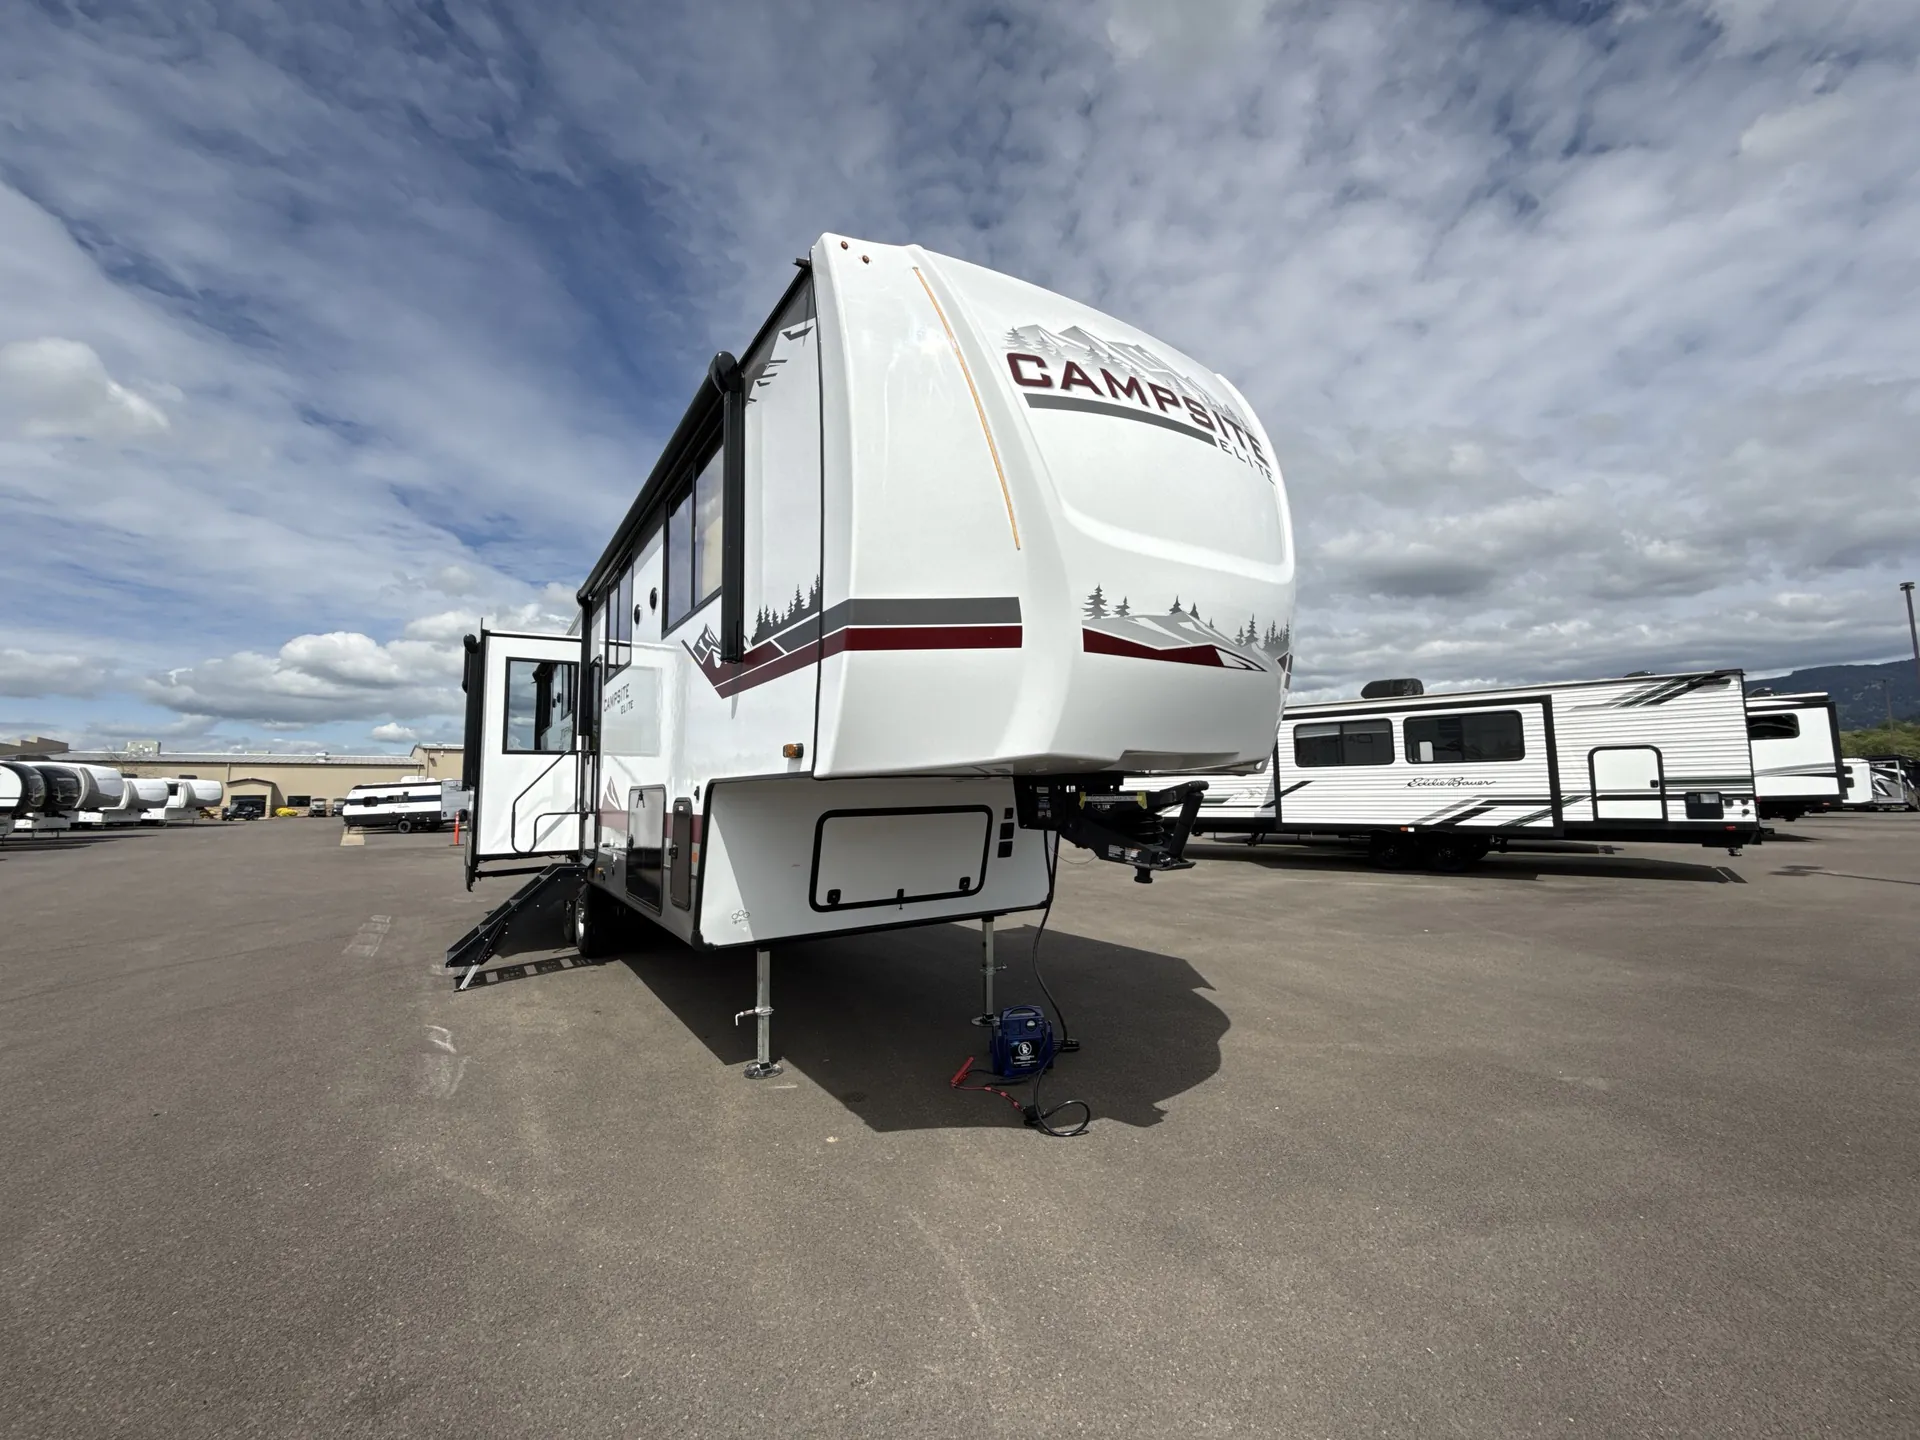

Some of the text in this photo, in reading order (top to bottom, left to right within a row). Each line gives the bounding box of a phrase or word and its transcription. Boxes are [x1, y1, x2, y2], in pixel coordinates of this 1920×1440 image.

[1006, 352, 1271, 468] CAMPSITE
[1218, 438, 1276, 486] ELITE
[603, 683, 630, 712] CAMPSITE
[620, 699, 634, 715] ELITE
[1404, 776, 1497, 788] Eddie Bauer
